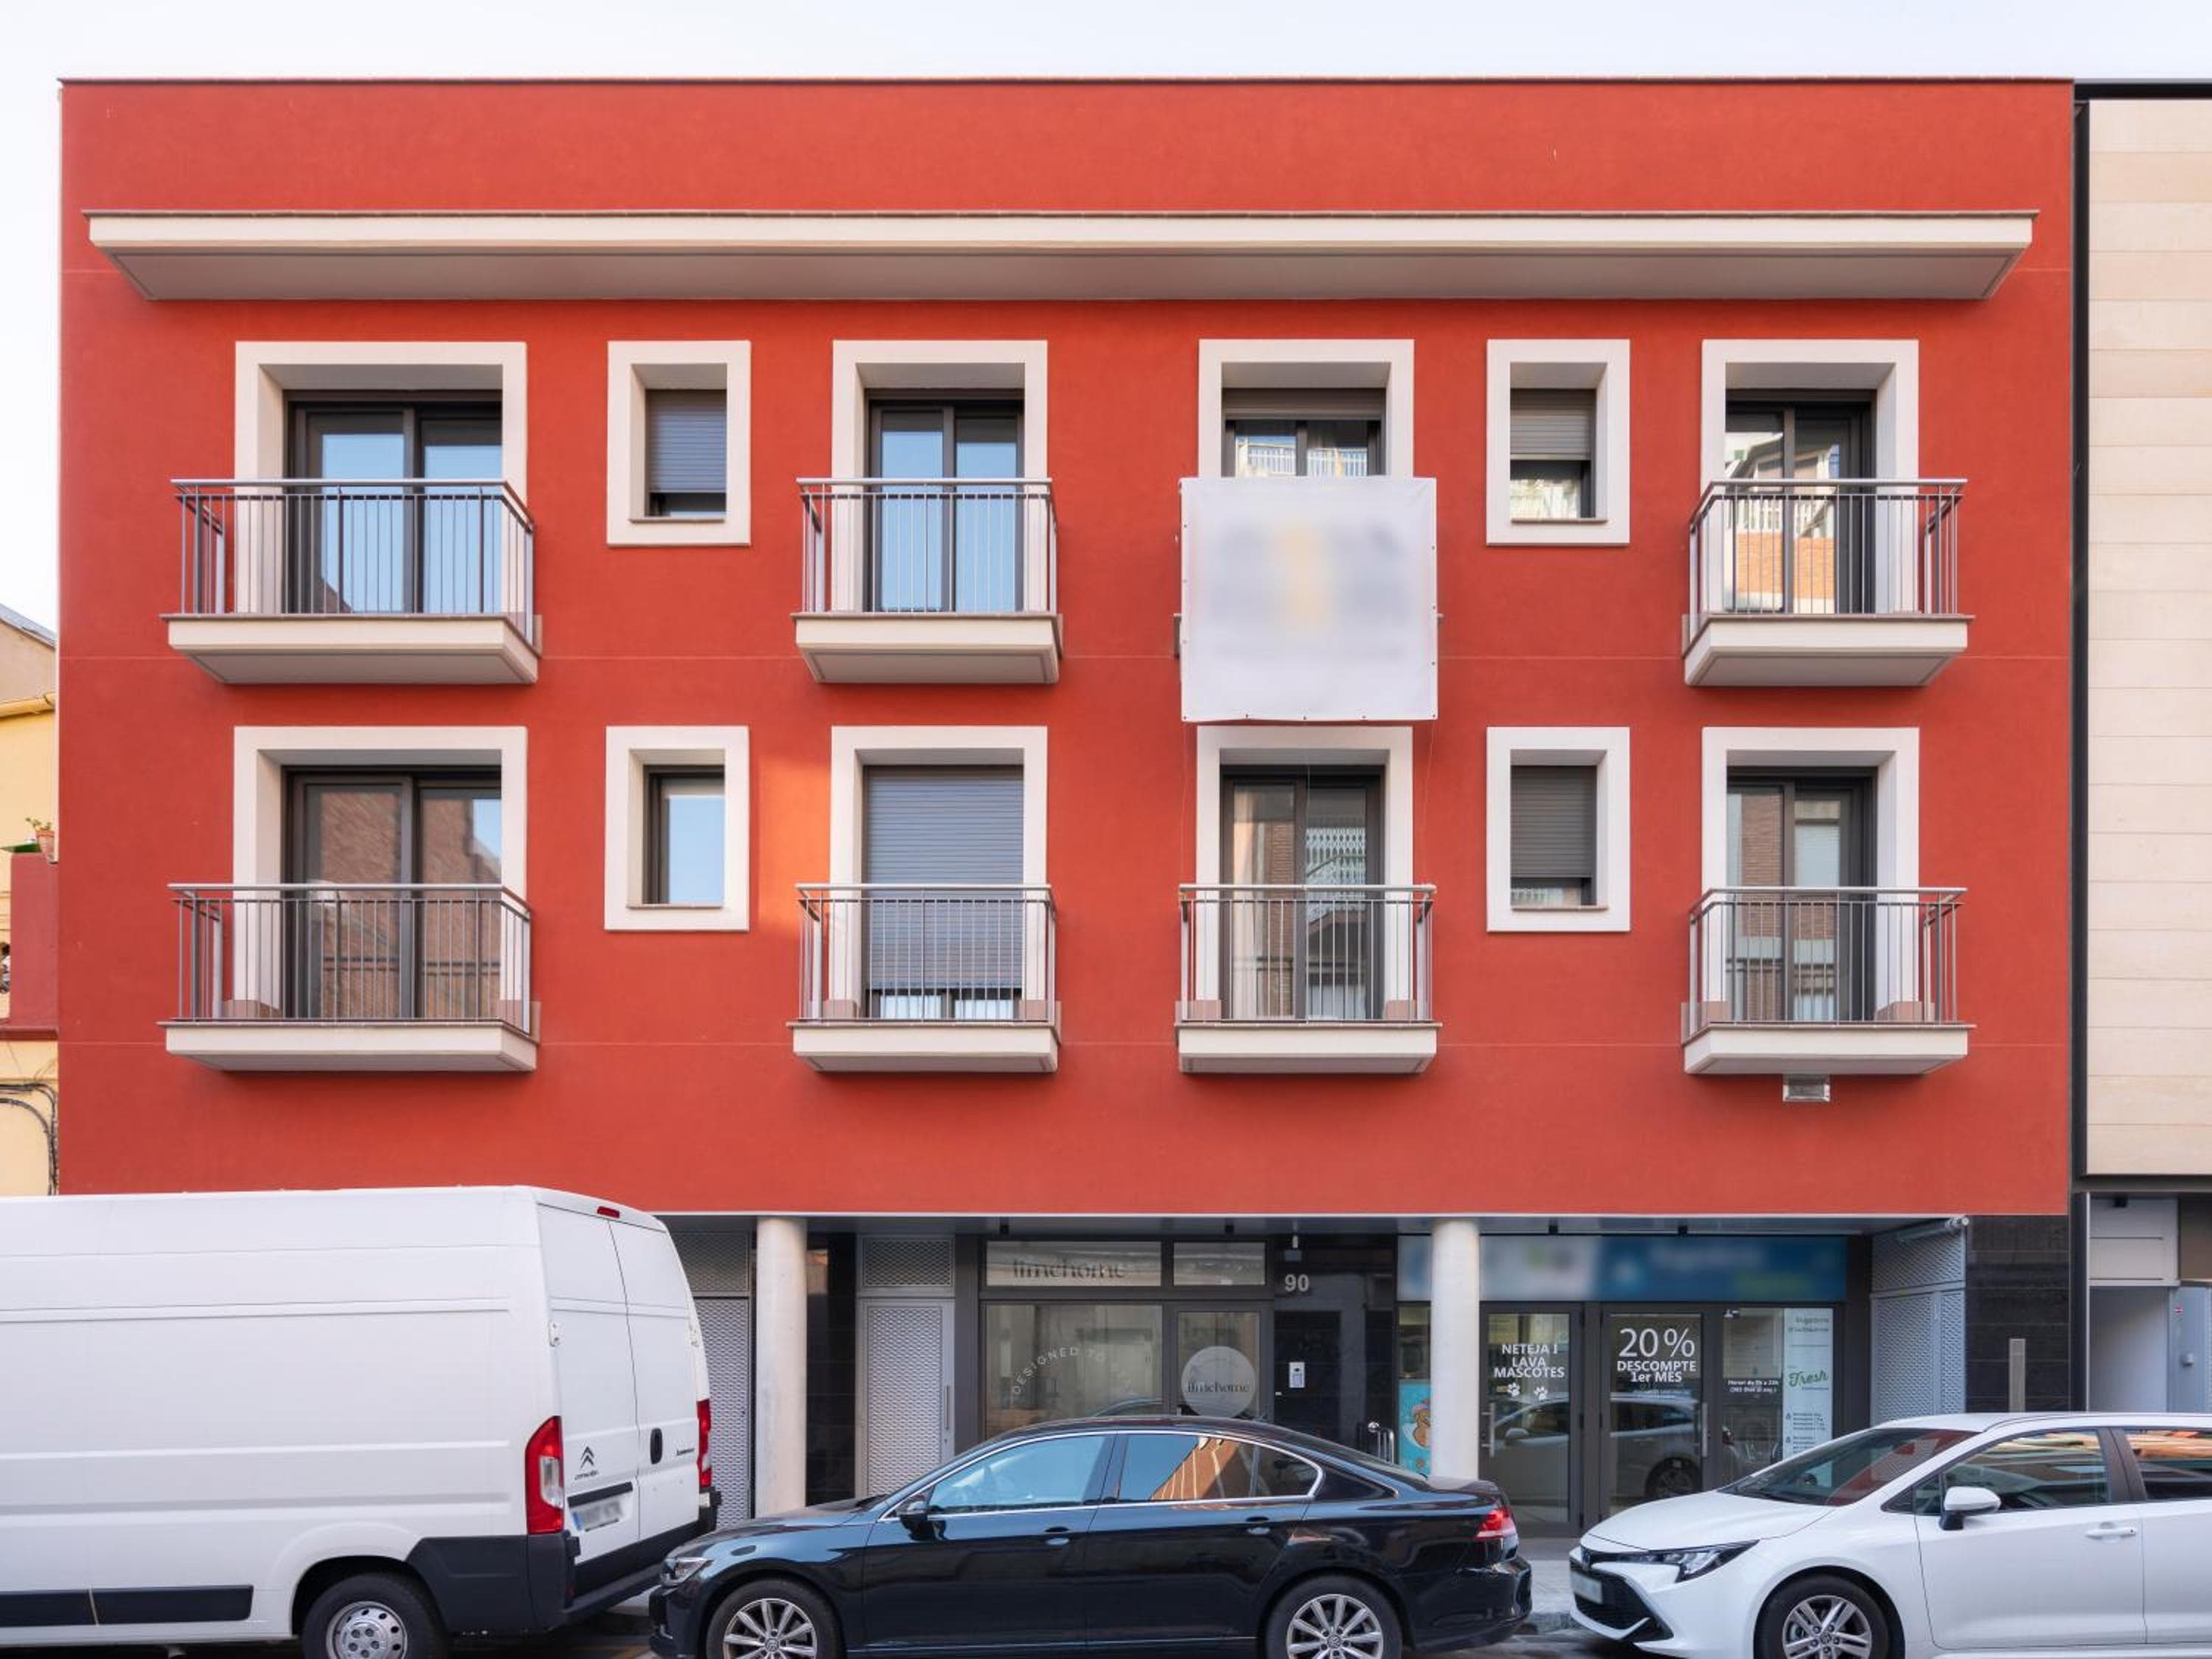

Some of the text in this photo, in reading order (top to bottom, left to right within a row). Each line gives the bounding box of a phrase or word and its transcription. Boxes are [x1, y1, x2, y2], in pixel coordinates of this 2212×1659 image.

[1285, 1273, 1310, 1292] 90
[1502, 1344, 1558, 1354] NETEJA I
[1512, 1357, 1546, 1368] LAVA
[1617, 1360, 1697, 1371] DESCOMPTE
[1014, 1346, 1079, 1395] DESIGNED
[1494, 1367, 1565, 1378] MASCOTES
[1630, 1371, 1682, 1382] 1er MES
